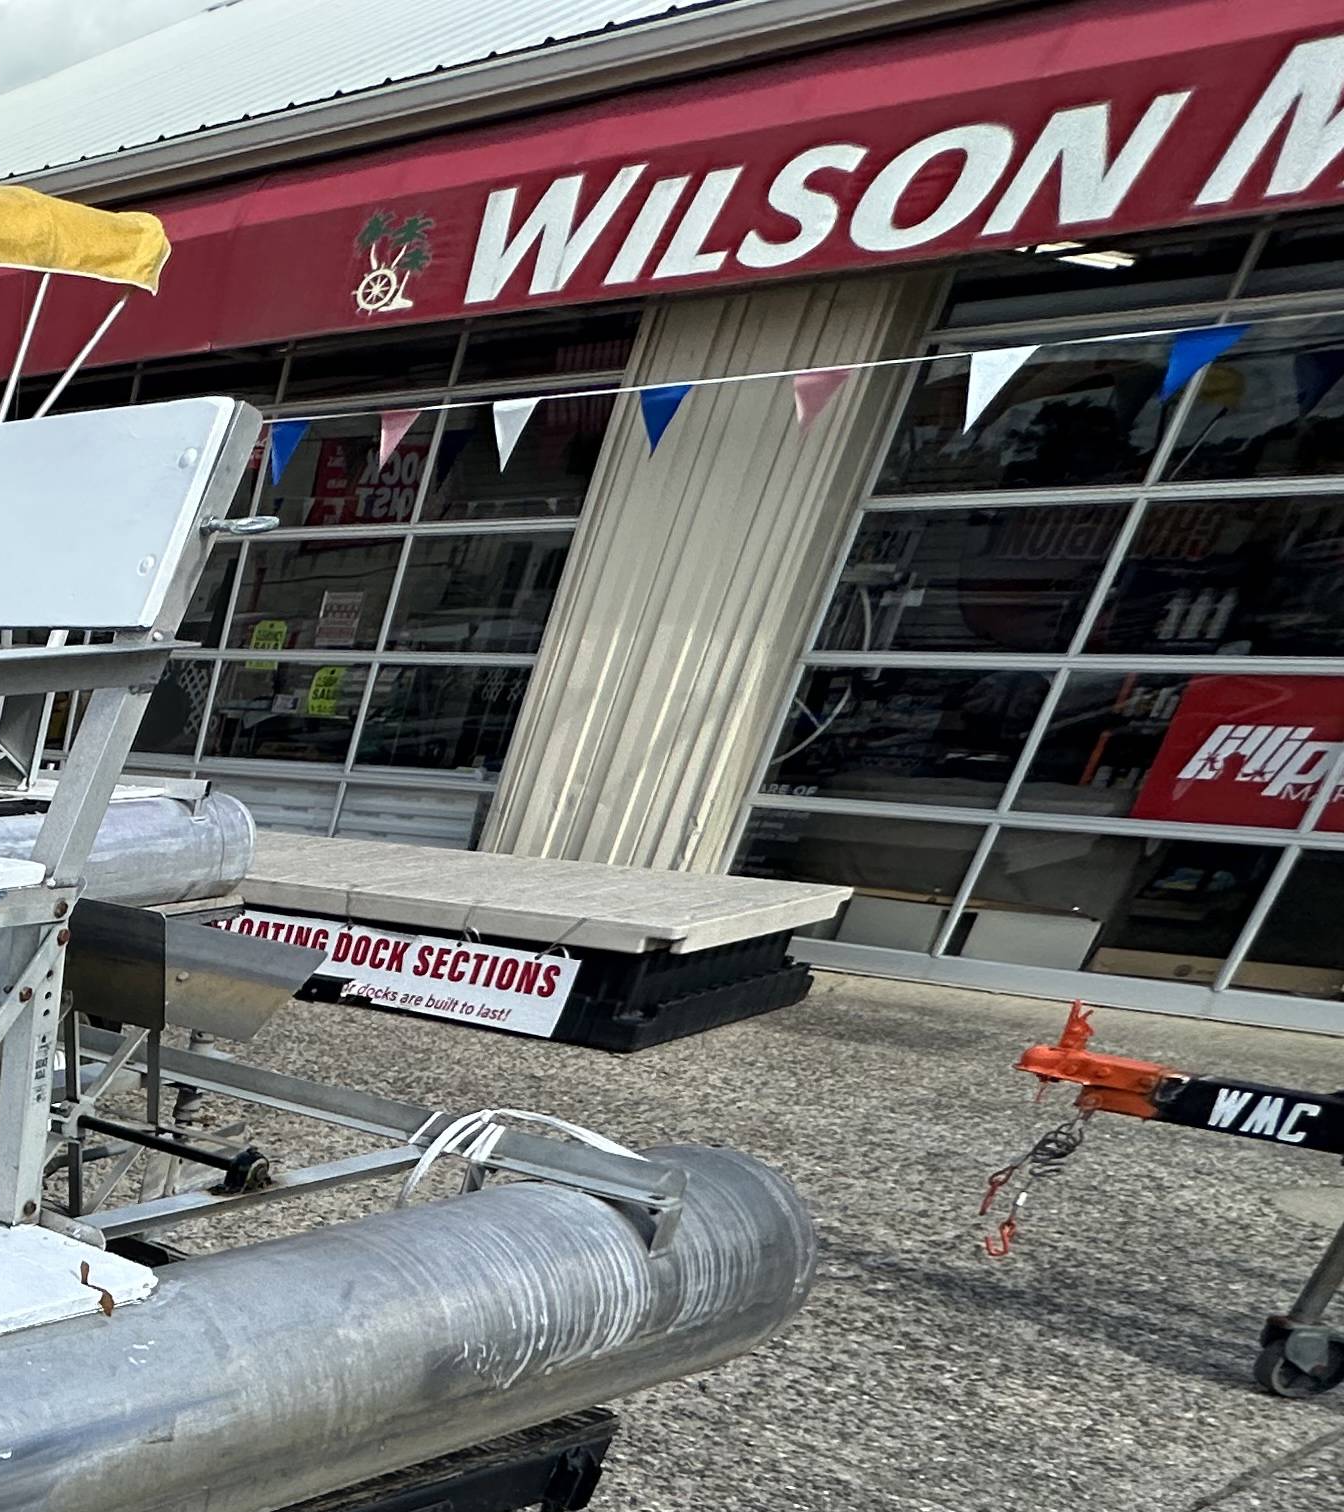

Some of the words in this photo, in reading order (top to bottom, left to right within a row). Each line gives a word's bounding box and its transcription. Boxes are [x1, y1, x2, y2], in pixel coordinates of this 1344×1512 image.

[464, 90, 1193, 305] WILSON
[331, 932, 410, 973] DOCK
[413, 945, 561, 998] SECTIONS
[357, 983, 398, 1002] docks
[399, 992, 423, 1007] are
[424, 993, 458, 1013] built
[459, 1001, 475, 1016] to
[476, 1003, 512, 1022] last!
[1208, 1088, 1322, 1143] WMC
